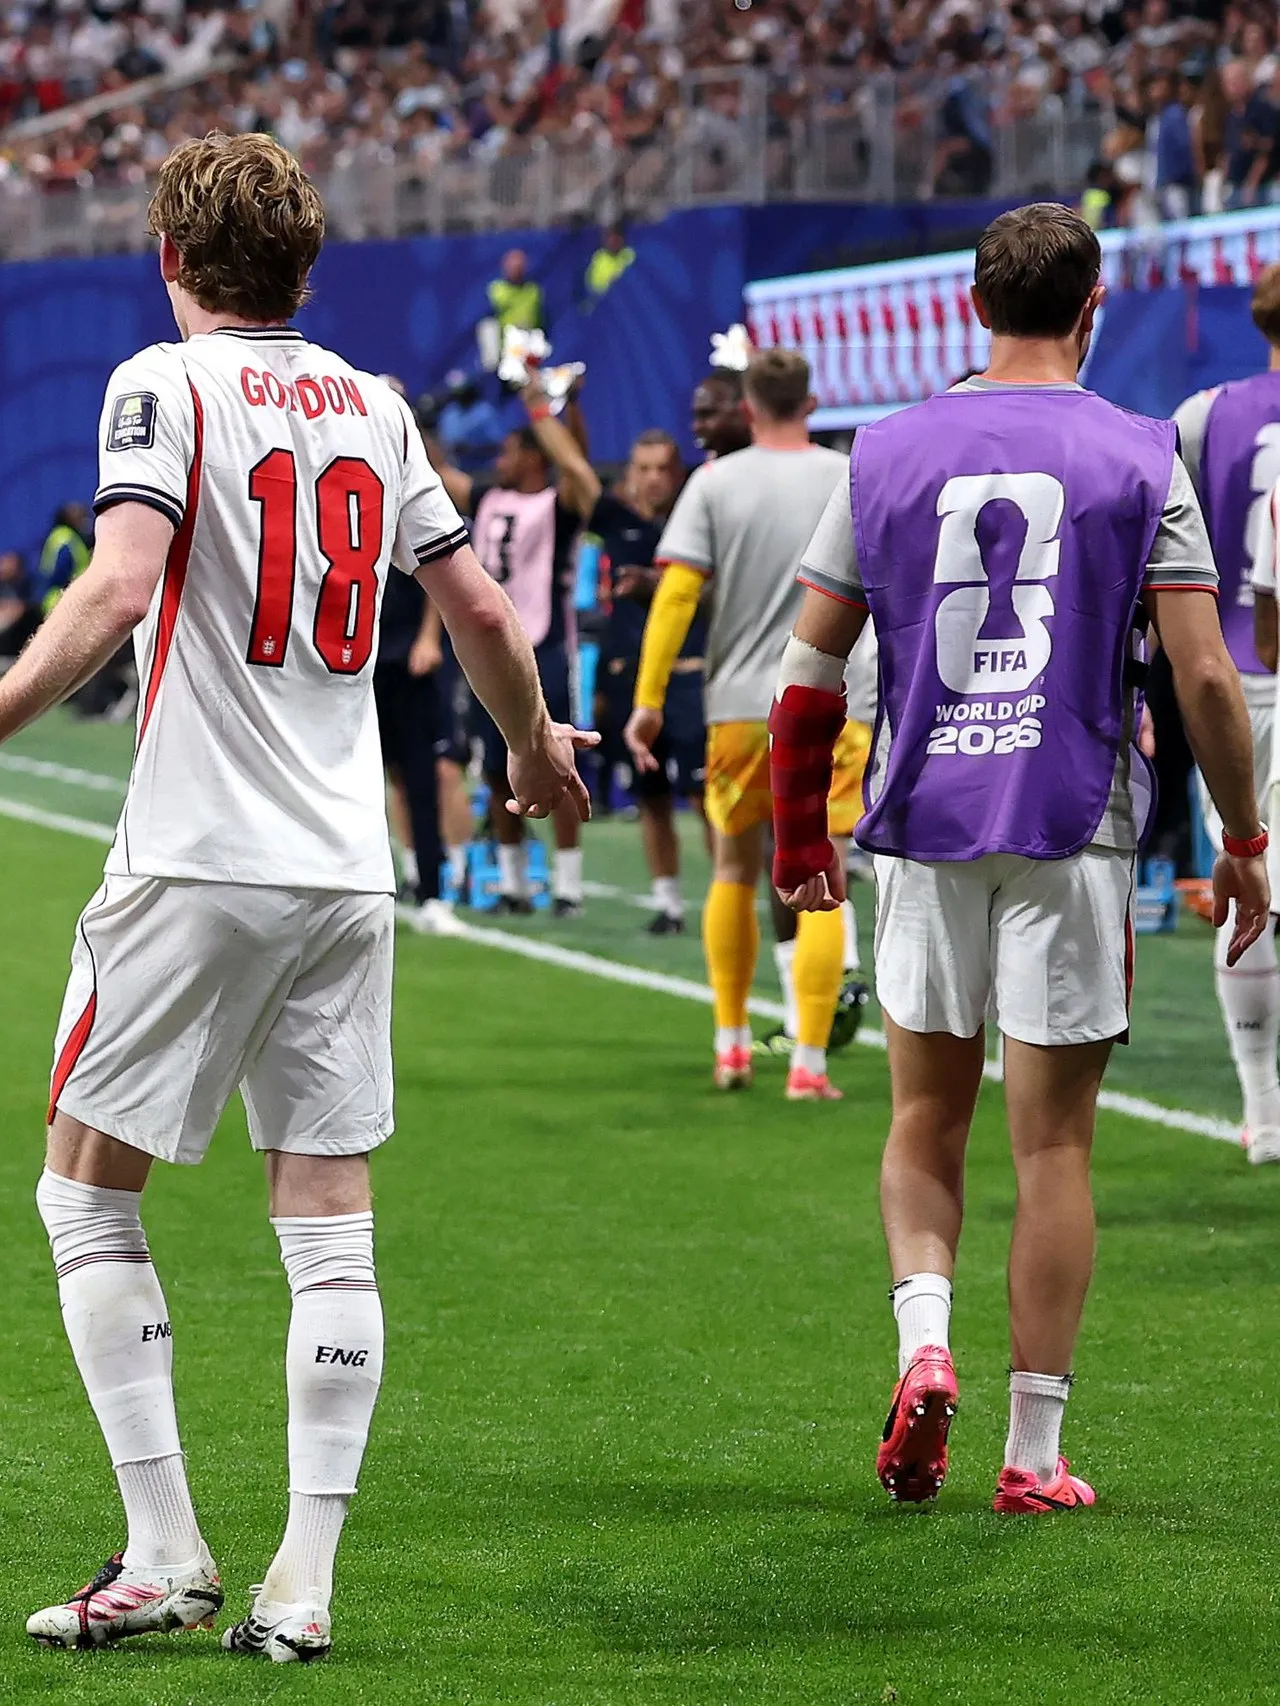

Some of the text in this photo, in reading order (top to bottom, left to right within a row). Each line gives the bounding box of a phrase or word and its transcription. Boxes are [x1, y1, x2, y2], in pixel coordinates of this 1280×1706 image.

[246, 447, 384, 676] 18
[974, 650, 1027, 673] FIFA
[935, 695, 1046, 722] WORLD CUP
[926, 718, 1042, 755] 2026
[315, 1346, 368, 1367] ENG
